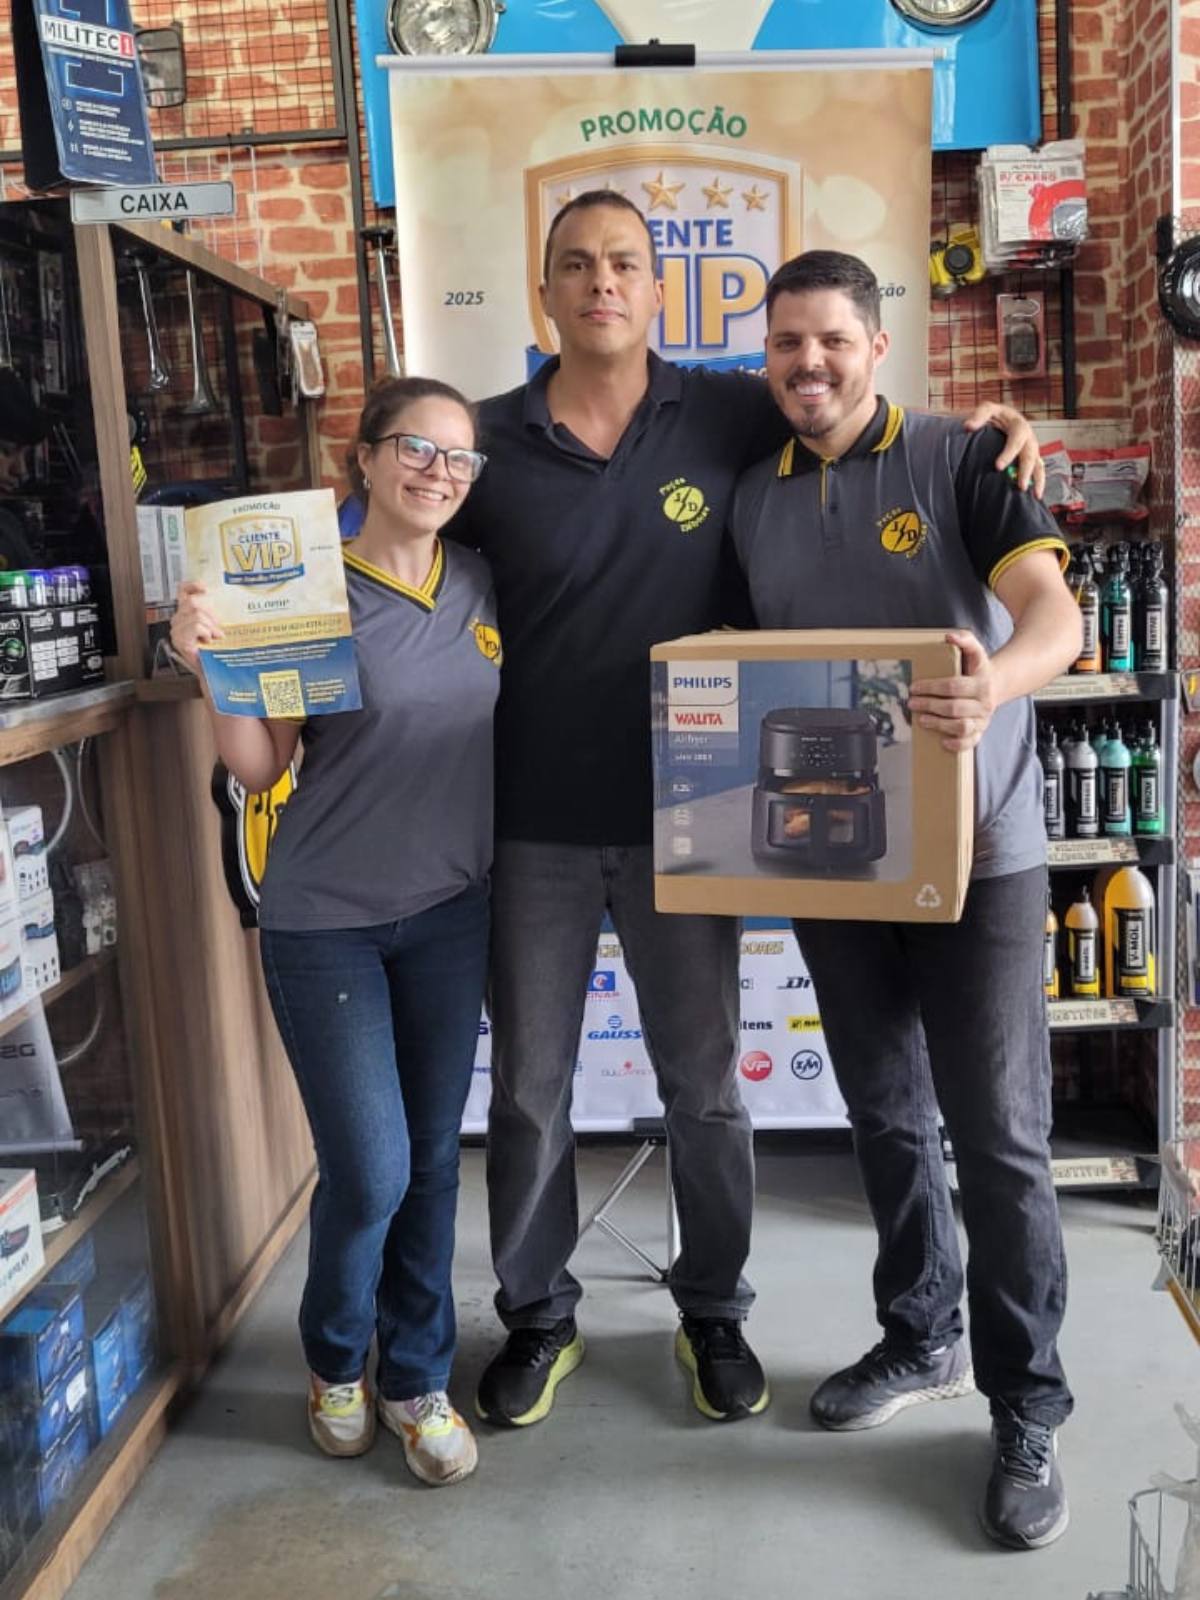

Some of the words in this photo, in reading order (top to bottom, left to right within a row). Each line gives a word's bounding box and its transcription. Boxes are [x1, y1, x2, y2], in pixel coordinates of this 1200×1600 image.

[580, 105, 748, 142] PROMOÇÃO
[121, 191, 188, 213] CAIXA
[648, 219, 733, 247] ENTE
[444, 291, 485, 305] 2025
[656, 253, 770, 349] IP
[239, 531, 281, 544] CLIENTE
[231, 541, 292, 572] VIP
[673, 677, 733, 689] PHILIPS
[675, 712, 723, 725] WALITA
[1131, 926, 1140, 962] V-MOL
[740, 1020, 773, 1030] tens
[587, 1030, 642, 1040] GAUSS
